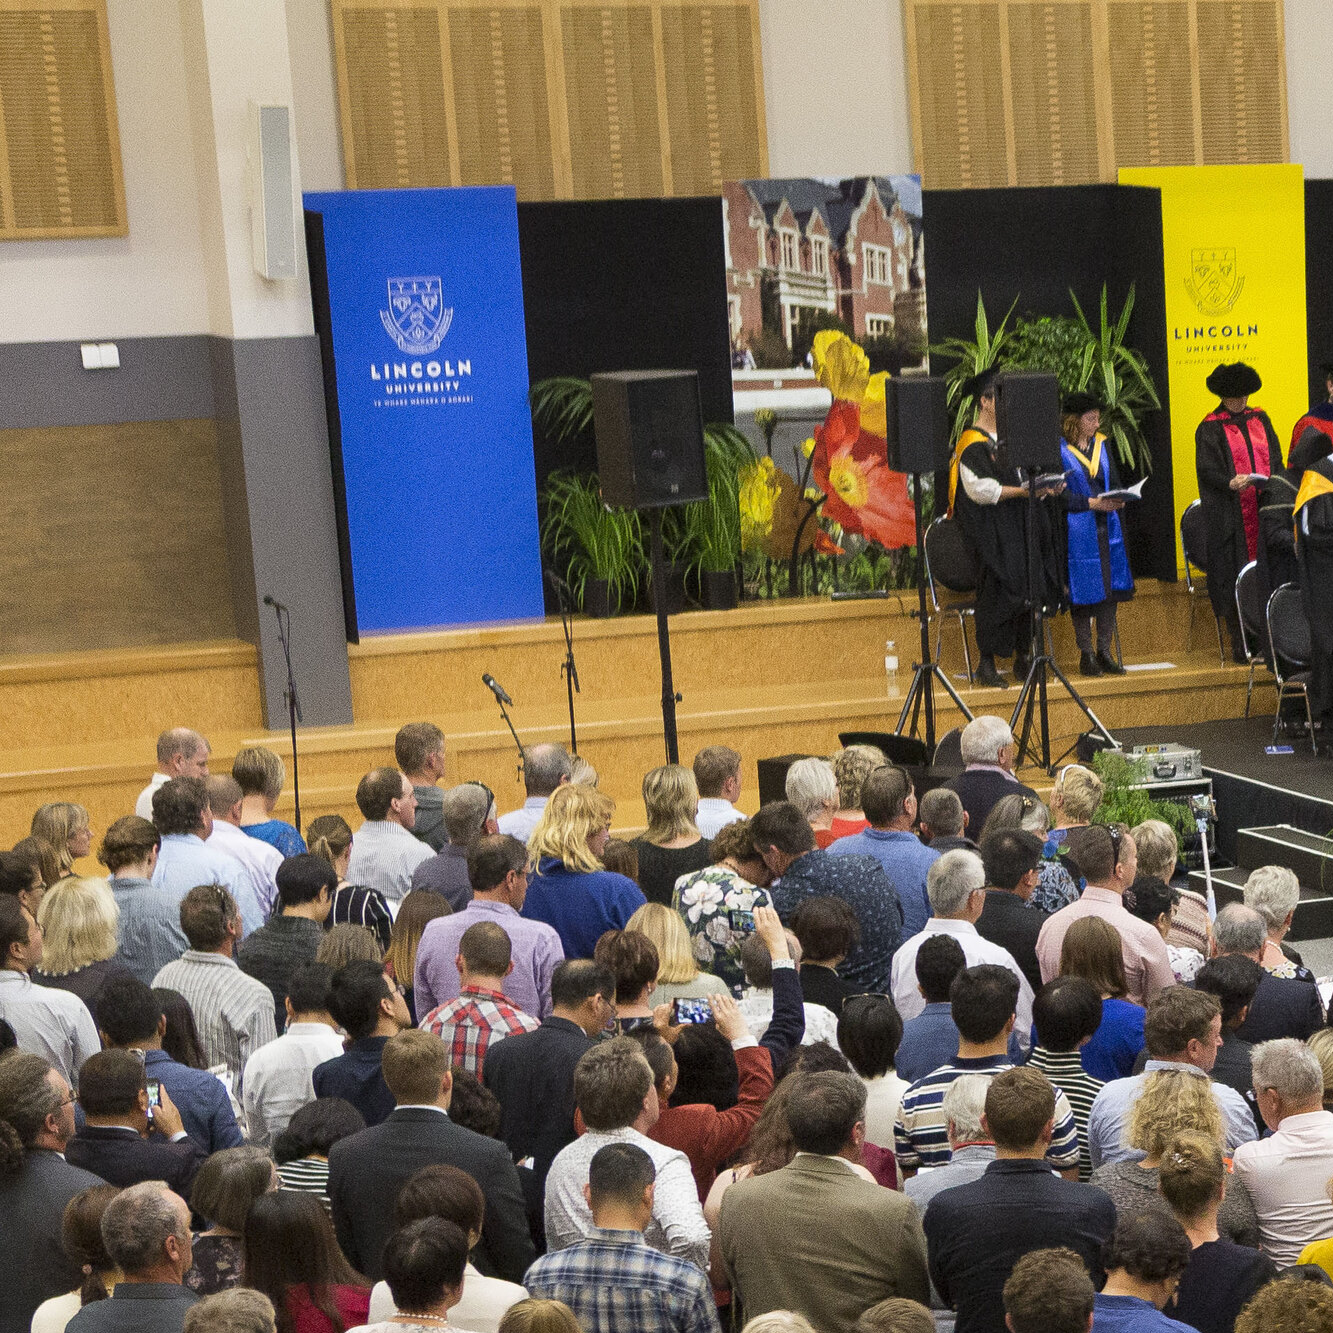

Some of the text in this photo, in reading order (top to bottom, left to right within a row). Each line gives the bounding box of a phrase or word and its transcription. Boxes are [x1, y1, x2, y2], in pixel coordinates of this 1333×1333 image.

[1174, 323, 1258, 340] LINCOLN
[1186, 343, 1248, 353] UNIVERSITY
[370, 359, 472, 380] LINCOLN
[386, 380, 459, 395] UNIVERSITY
